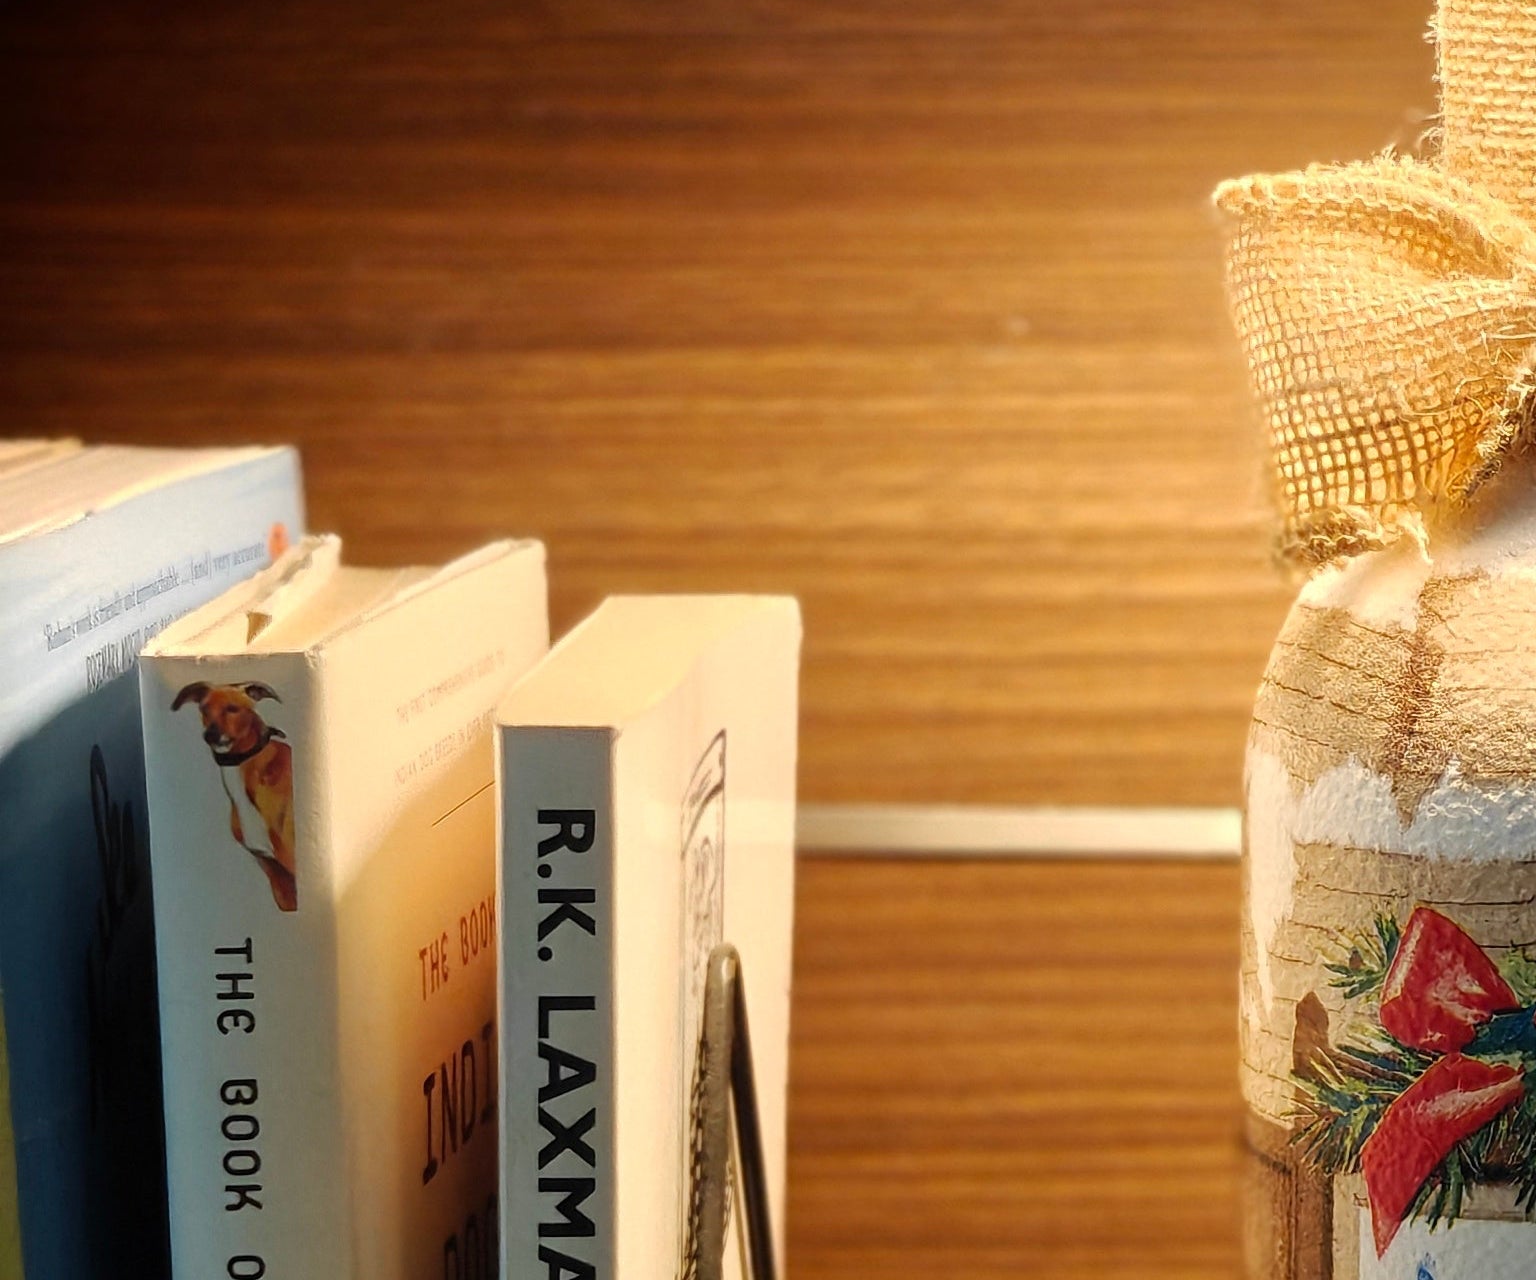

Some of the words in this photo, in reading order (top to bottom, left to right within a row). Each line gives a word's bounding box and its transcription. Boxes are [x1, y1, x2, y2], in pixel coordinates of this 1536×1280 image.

[536, 808, 597, 963] R.K.
[213, 936, 256, 1036] THE
[419, 930, 449, 1001] THE
[218, 1078, 264, 1212] BOOK
[423, 1021, 495, 1187] INDI
